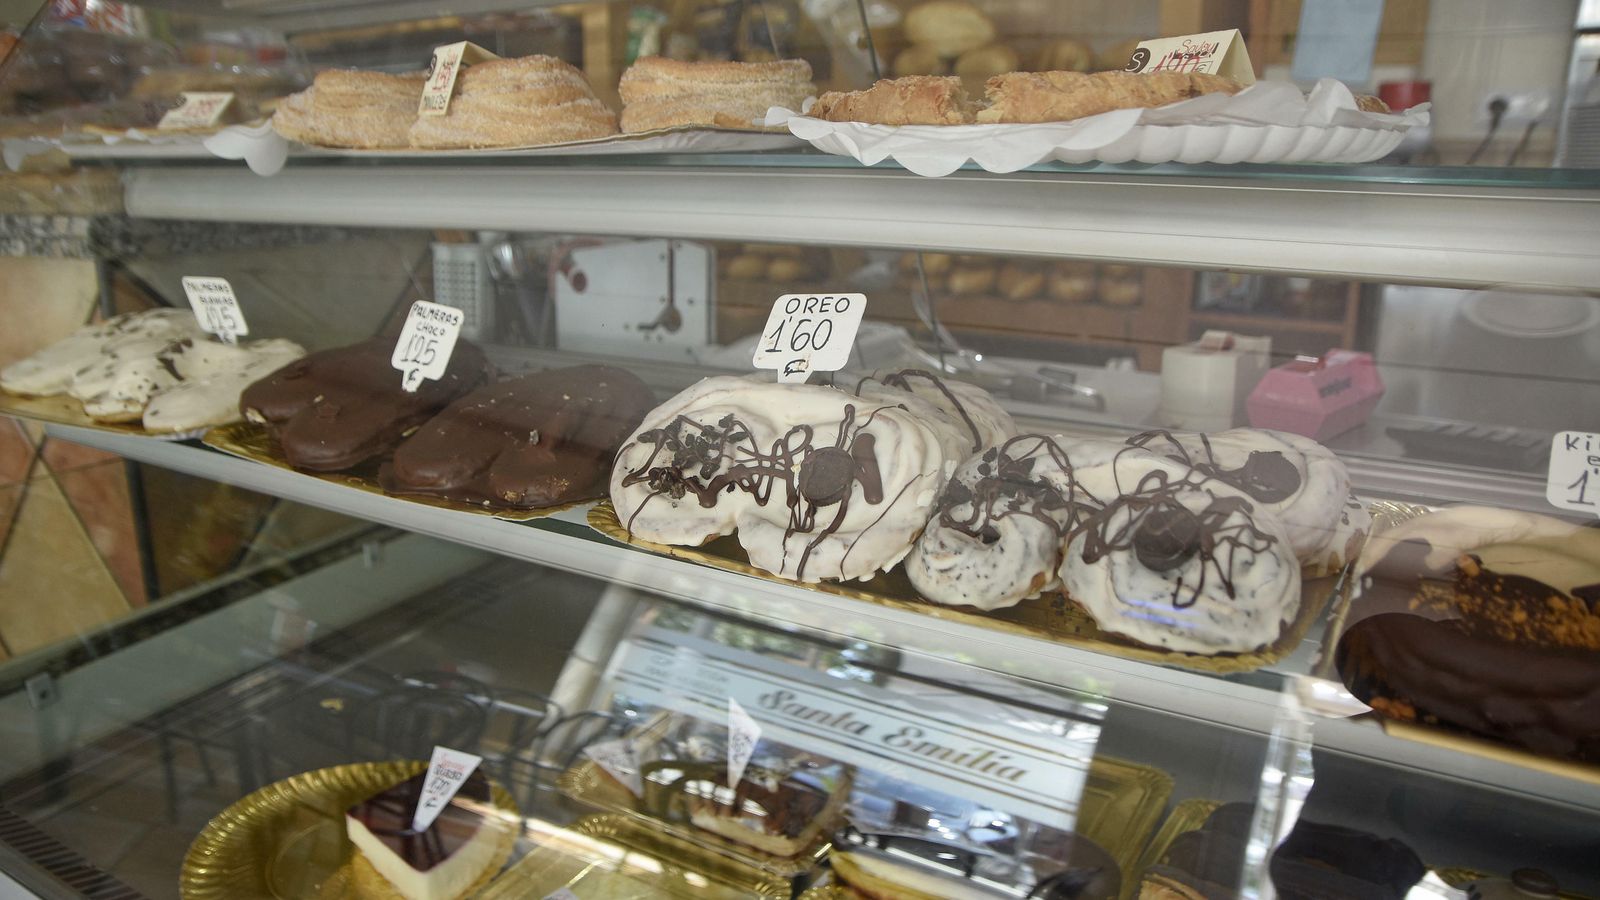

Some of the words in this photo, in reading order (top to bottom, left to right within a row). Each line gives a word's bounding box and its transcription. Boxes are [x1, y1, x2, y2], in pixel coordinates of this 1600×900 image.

[411, 303, 459, 326] PALMERAS
[785, 297, 850, 314] OREO
[416, 321, 446, 336] CHOCO
[765, 316, 832, 352] 1'60
[1566, 433, 1600, 451] Ki
[759, 690, 871, 735] Santa
